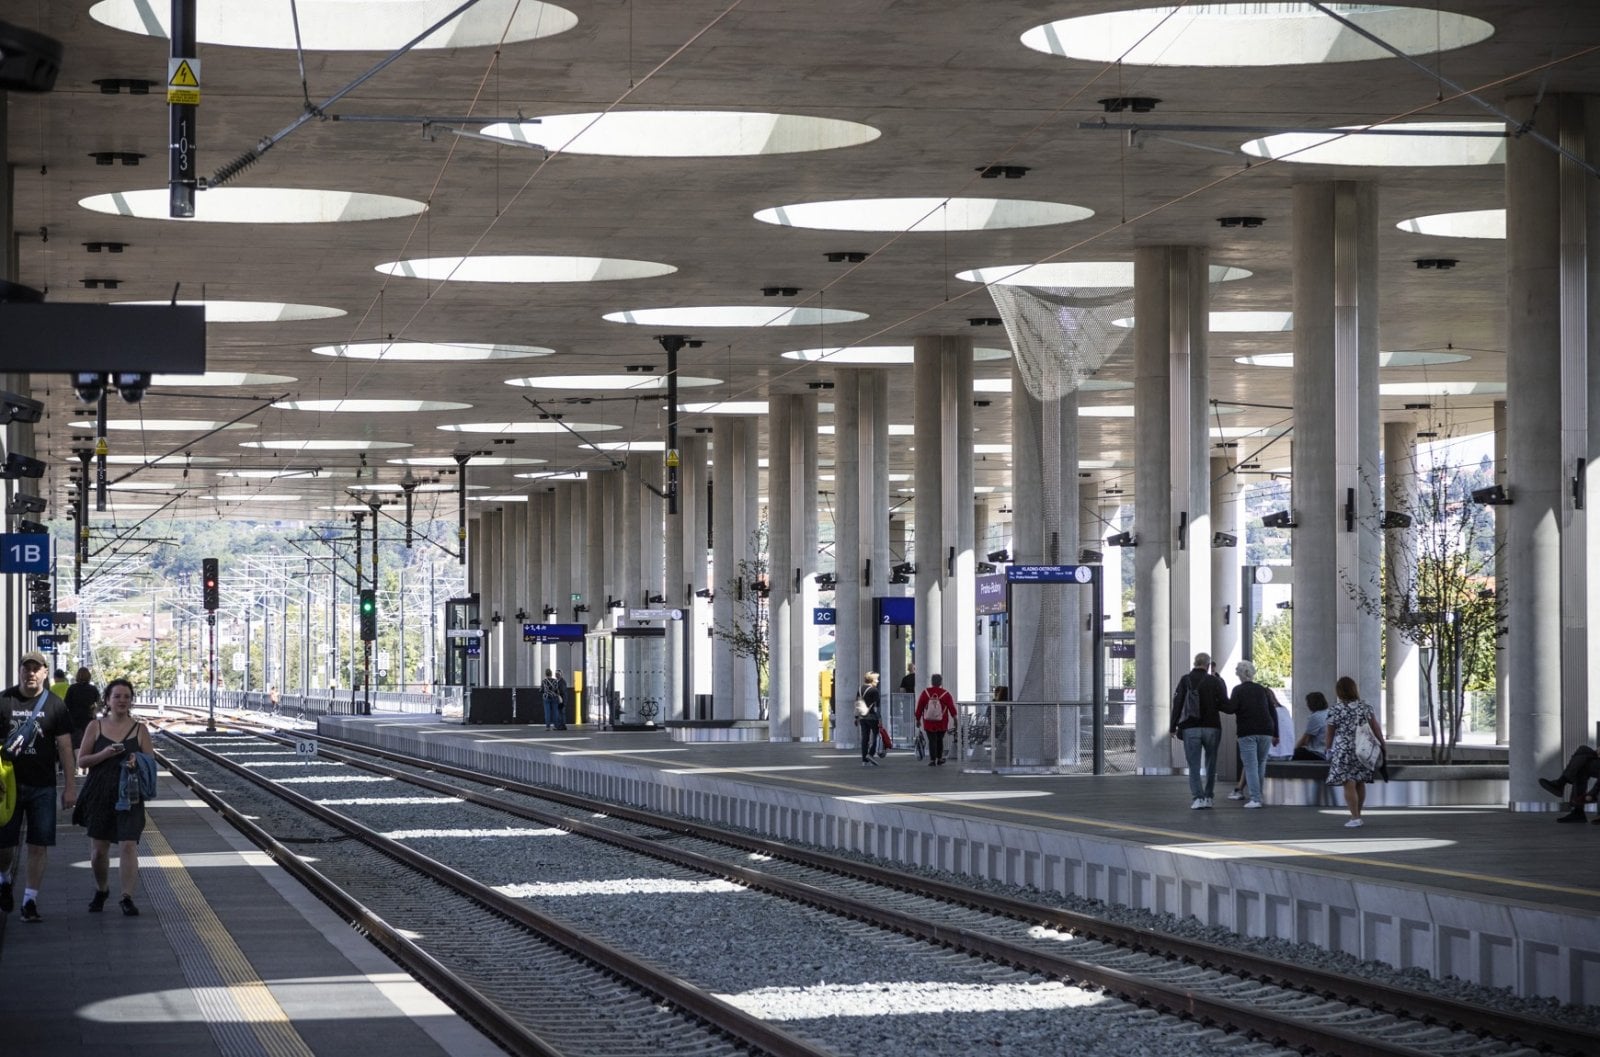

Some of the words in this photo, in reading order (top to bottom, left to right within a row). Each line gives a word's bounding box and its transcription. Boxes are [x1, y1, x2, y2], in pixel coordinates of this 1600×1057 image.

[180, 120, 188, 171] 103
[10, 544, 41, 562] 1B
[816, 612, 831, 621] 2C
[883, 615, 890, 624] 2
[35, 618, 49, 627] 1C
[299, 742, 314, 753] 0,3
